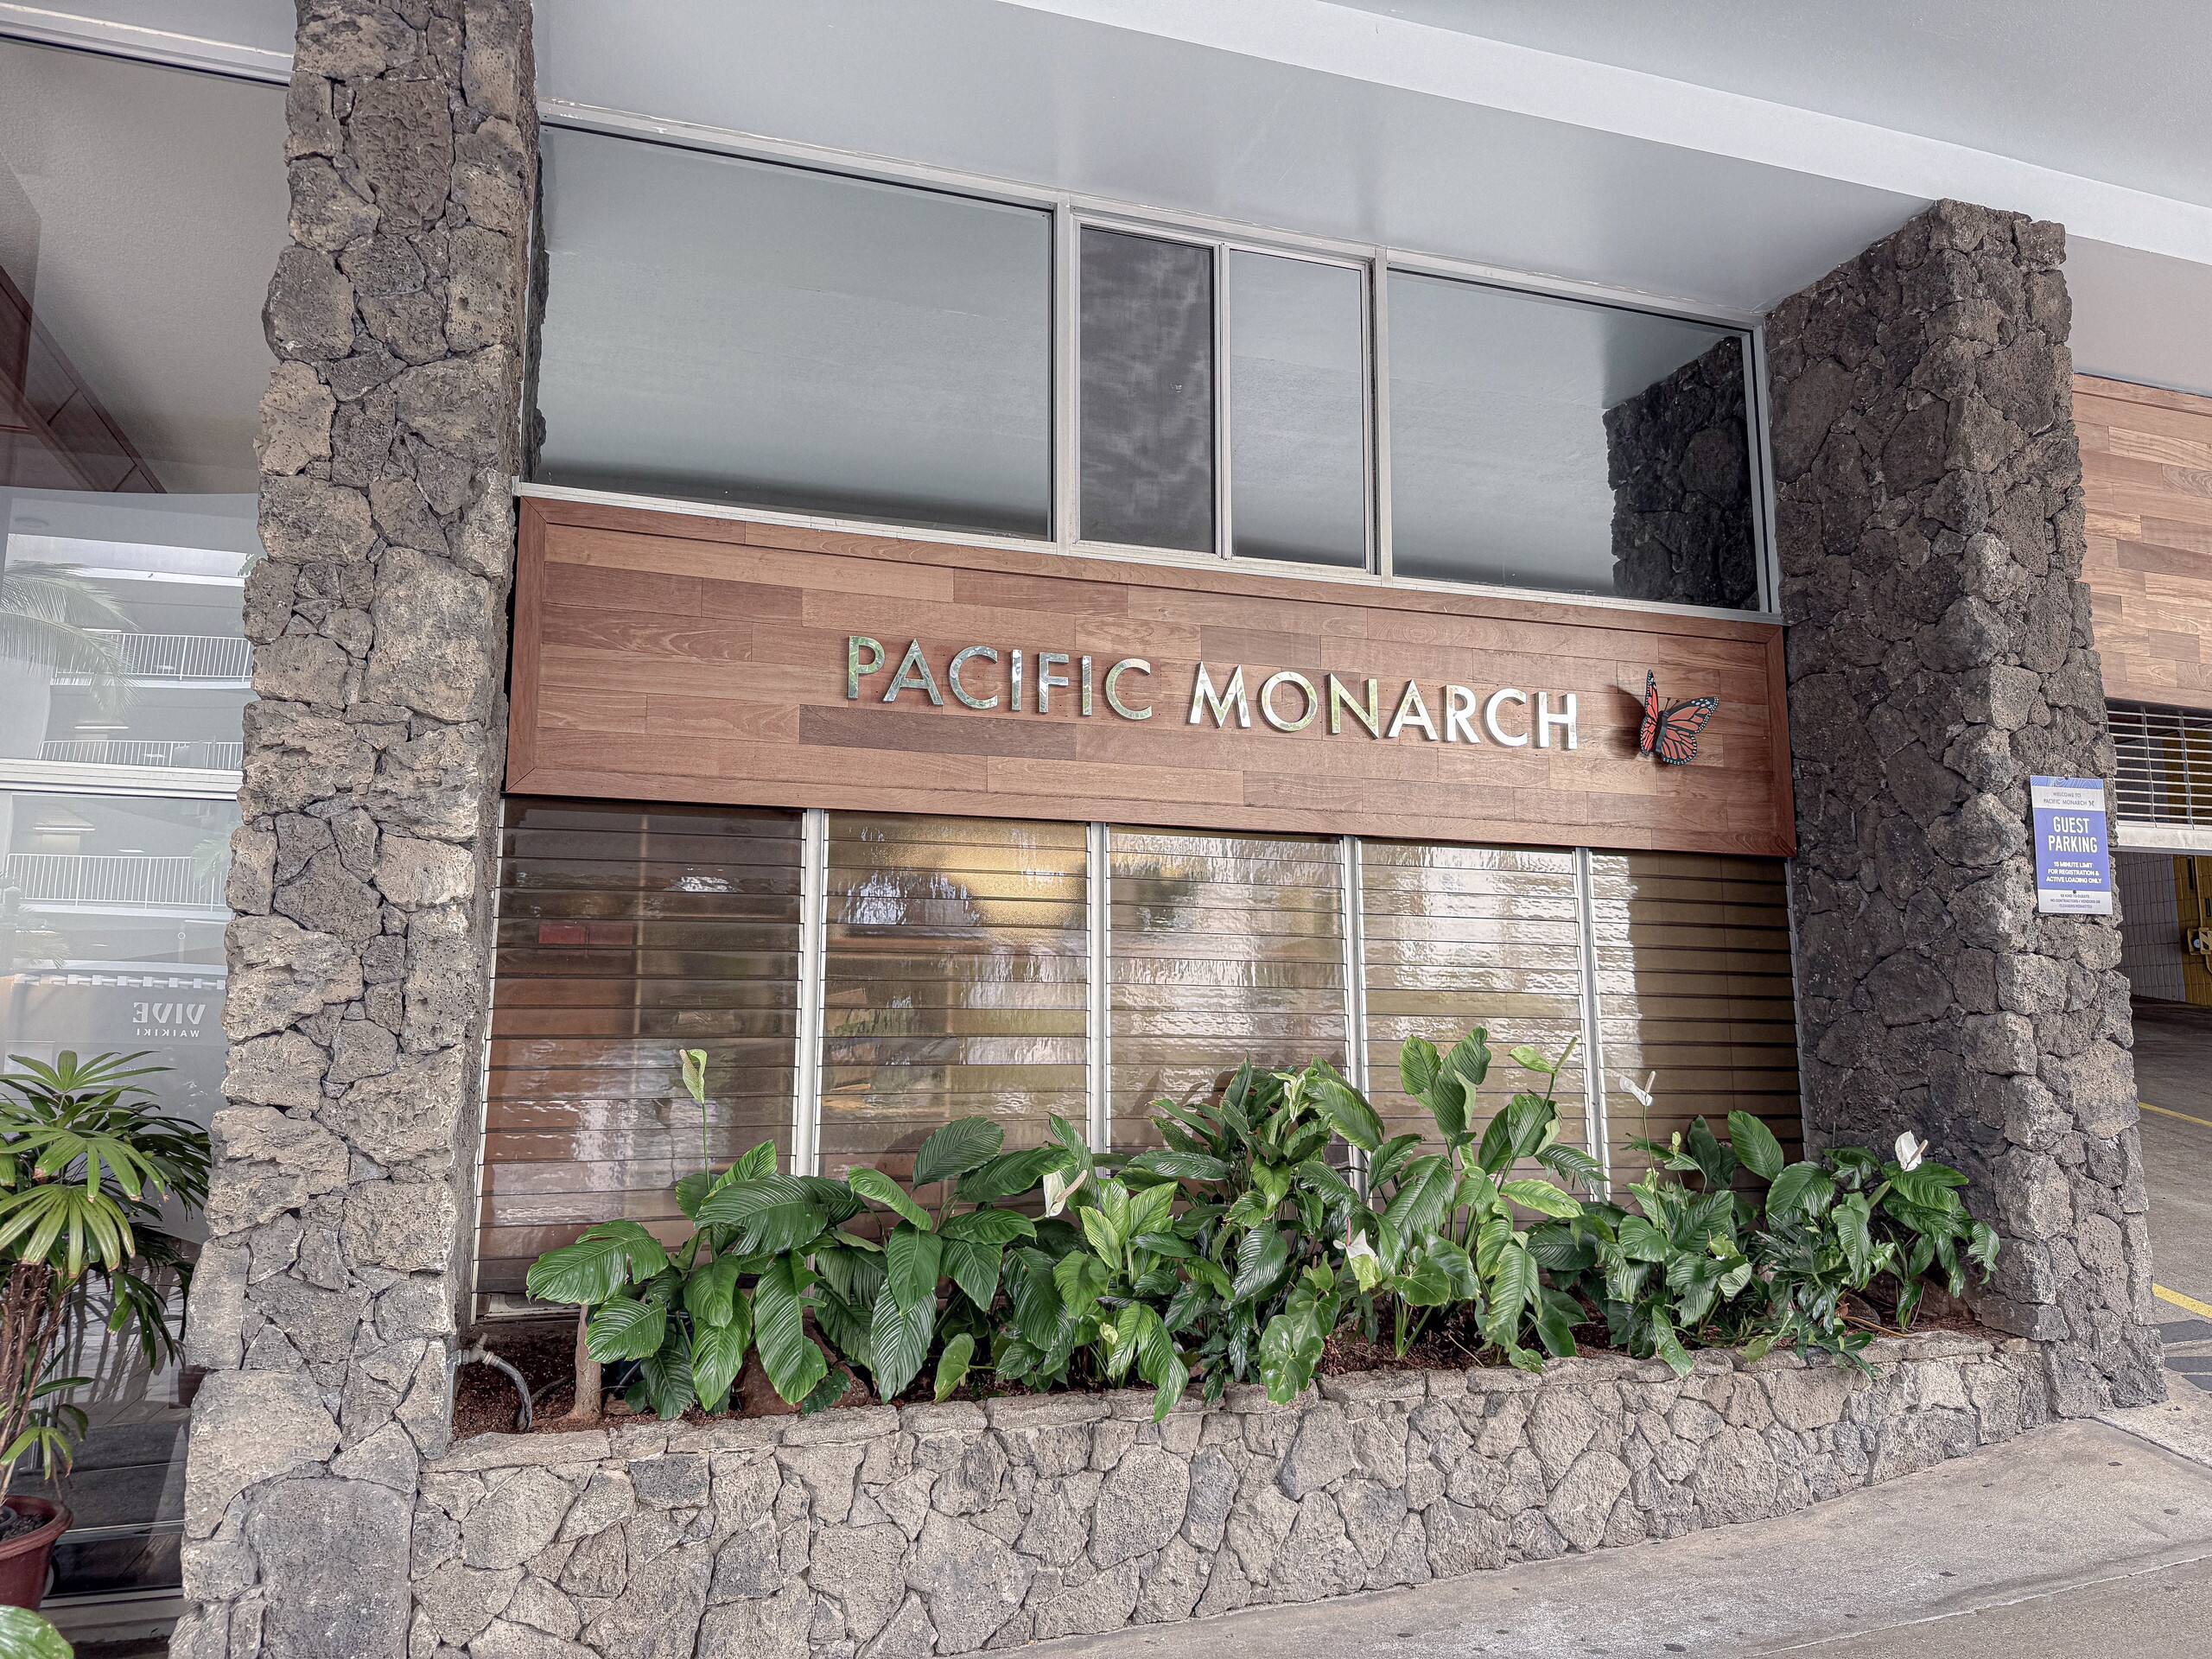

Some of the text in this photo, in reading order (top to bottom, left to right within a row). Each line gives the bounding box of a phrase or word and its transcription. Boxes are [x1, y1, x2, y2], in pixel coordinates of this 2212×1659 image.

[846, 634, 1578, 751] PACIFIC MONARCH
[2053, 816, 2089, 834] GUEST
[2048, 835, 2098, 854] PARKING
